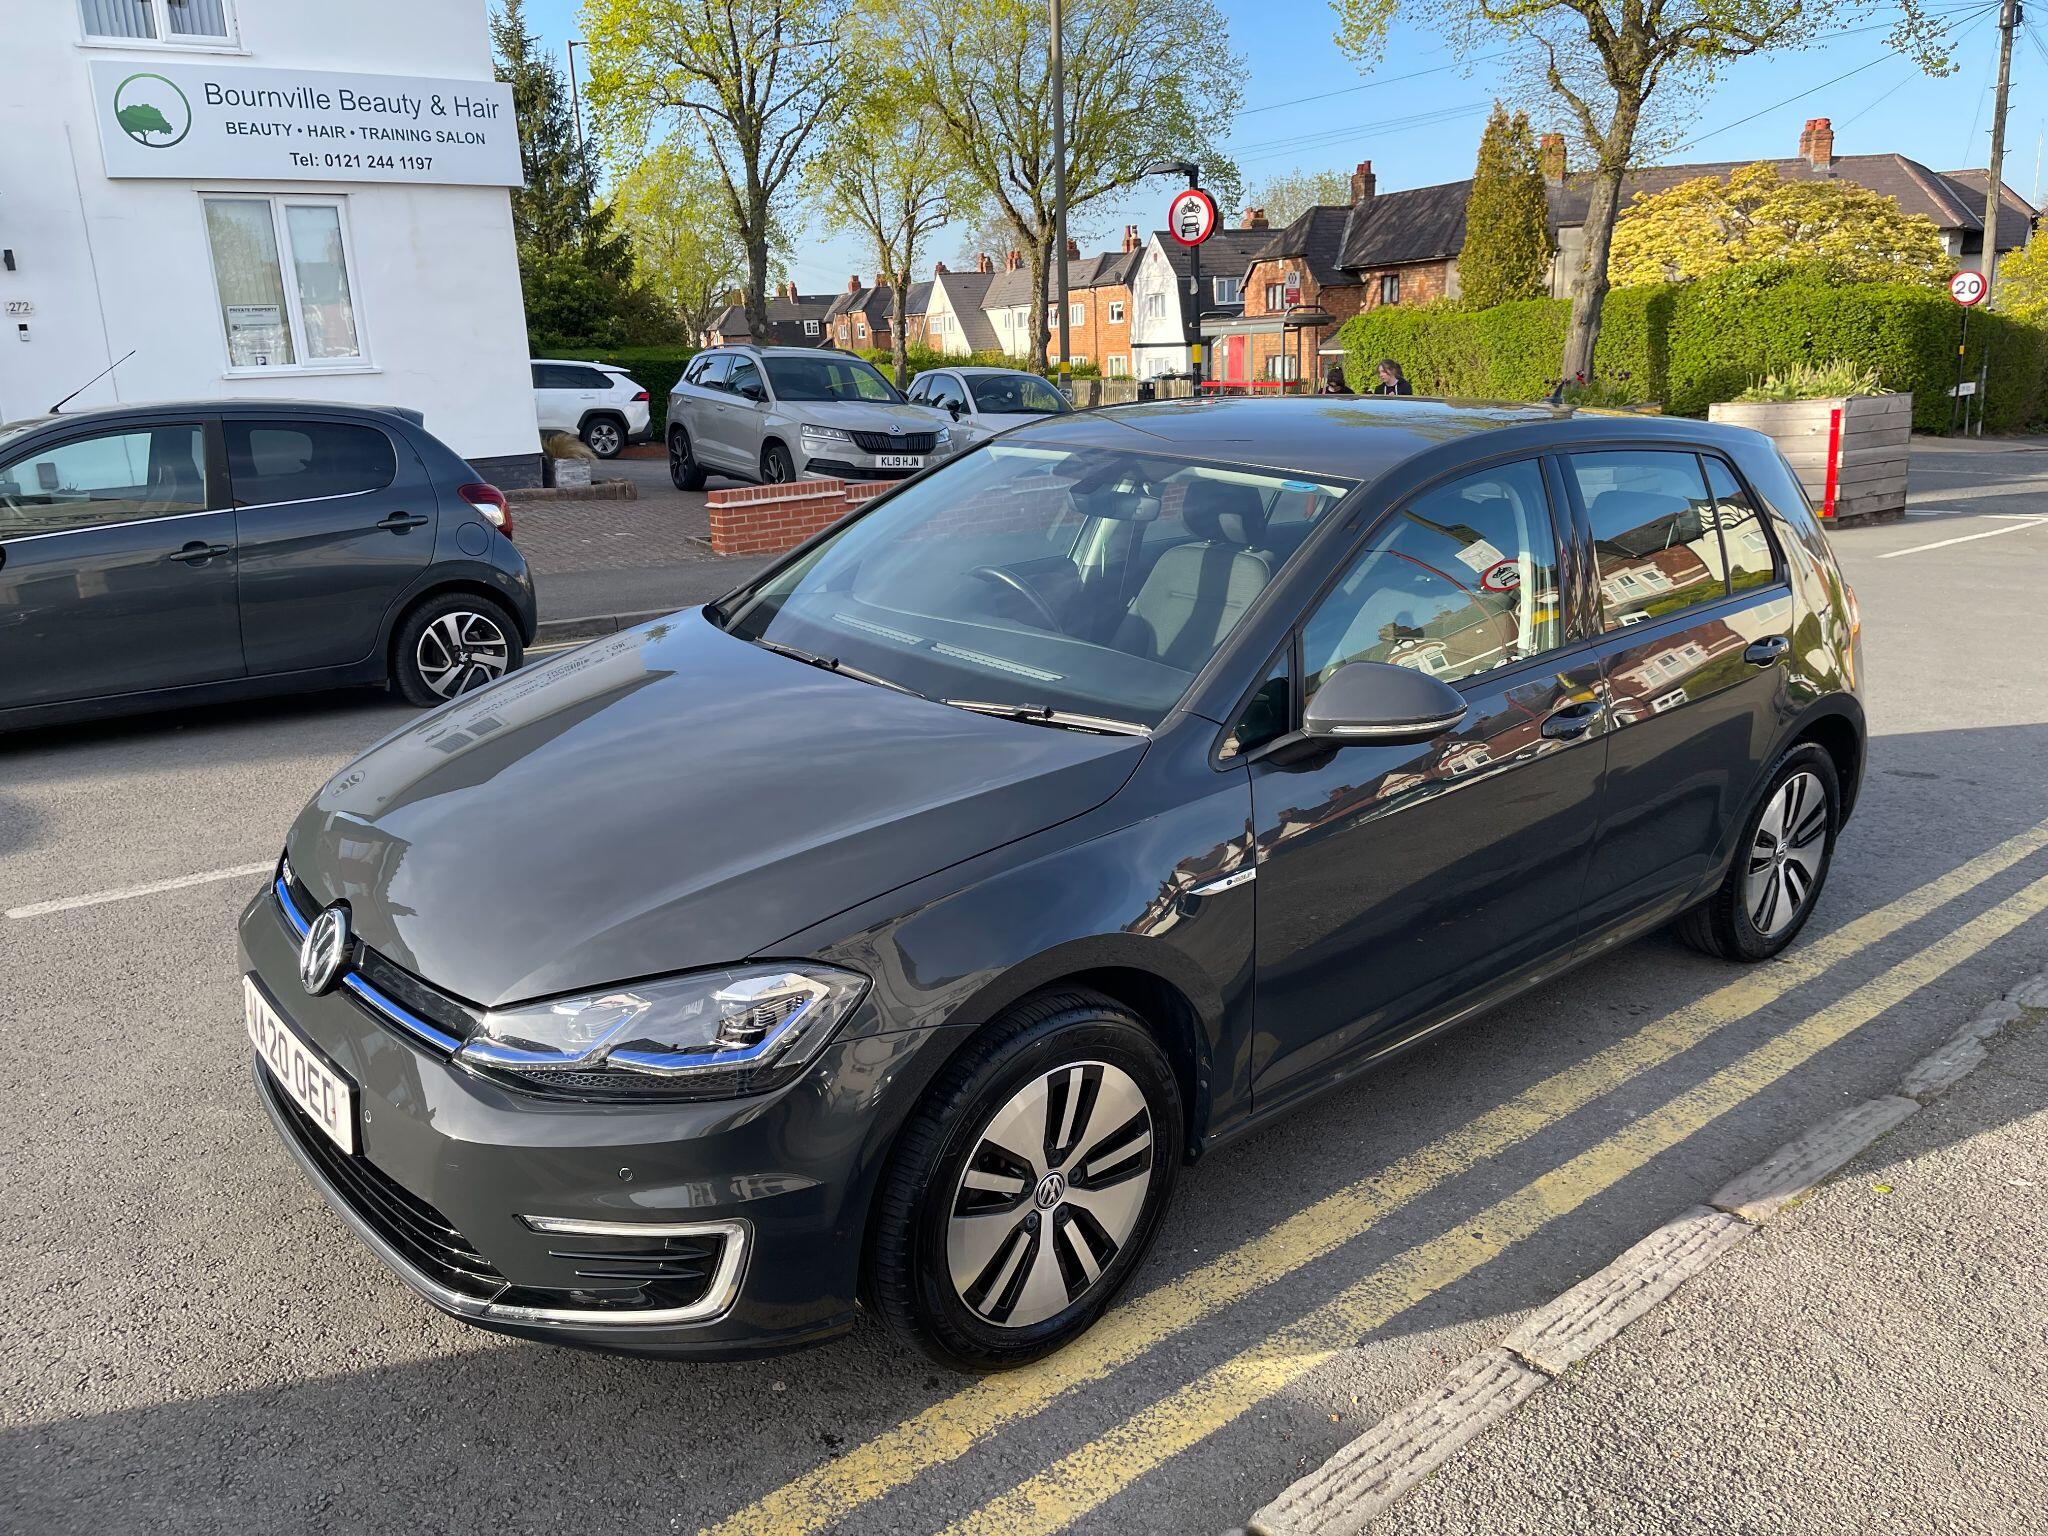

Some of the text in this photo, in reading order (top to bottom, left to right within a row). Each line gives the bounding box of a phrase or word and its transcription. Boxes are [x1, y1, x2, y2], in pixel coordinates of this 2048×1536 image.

[204, 82, 499, 120] Bournville Beauty & Hair
[225, 121, 486, 145] BEAUTY HAIR TRAINING SALON
[289, 152, 433, 170] Tel: 0121 244 1197
[1954, 280, 1981, 295] 20
[9, 301, 30, 312] 272
[881, 456, 919, 467] KL19 HJN
